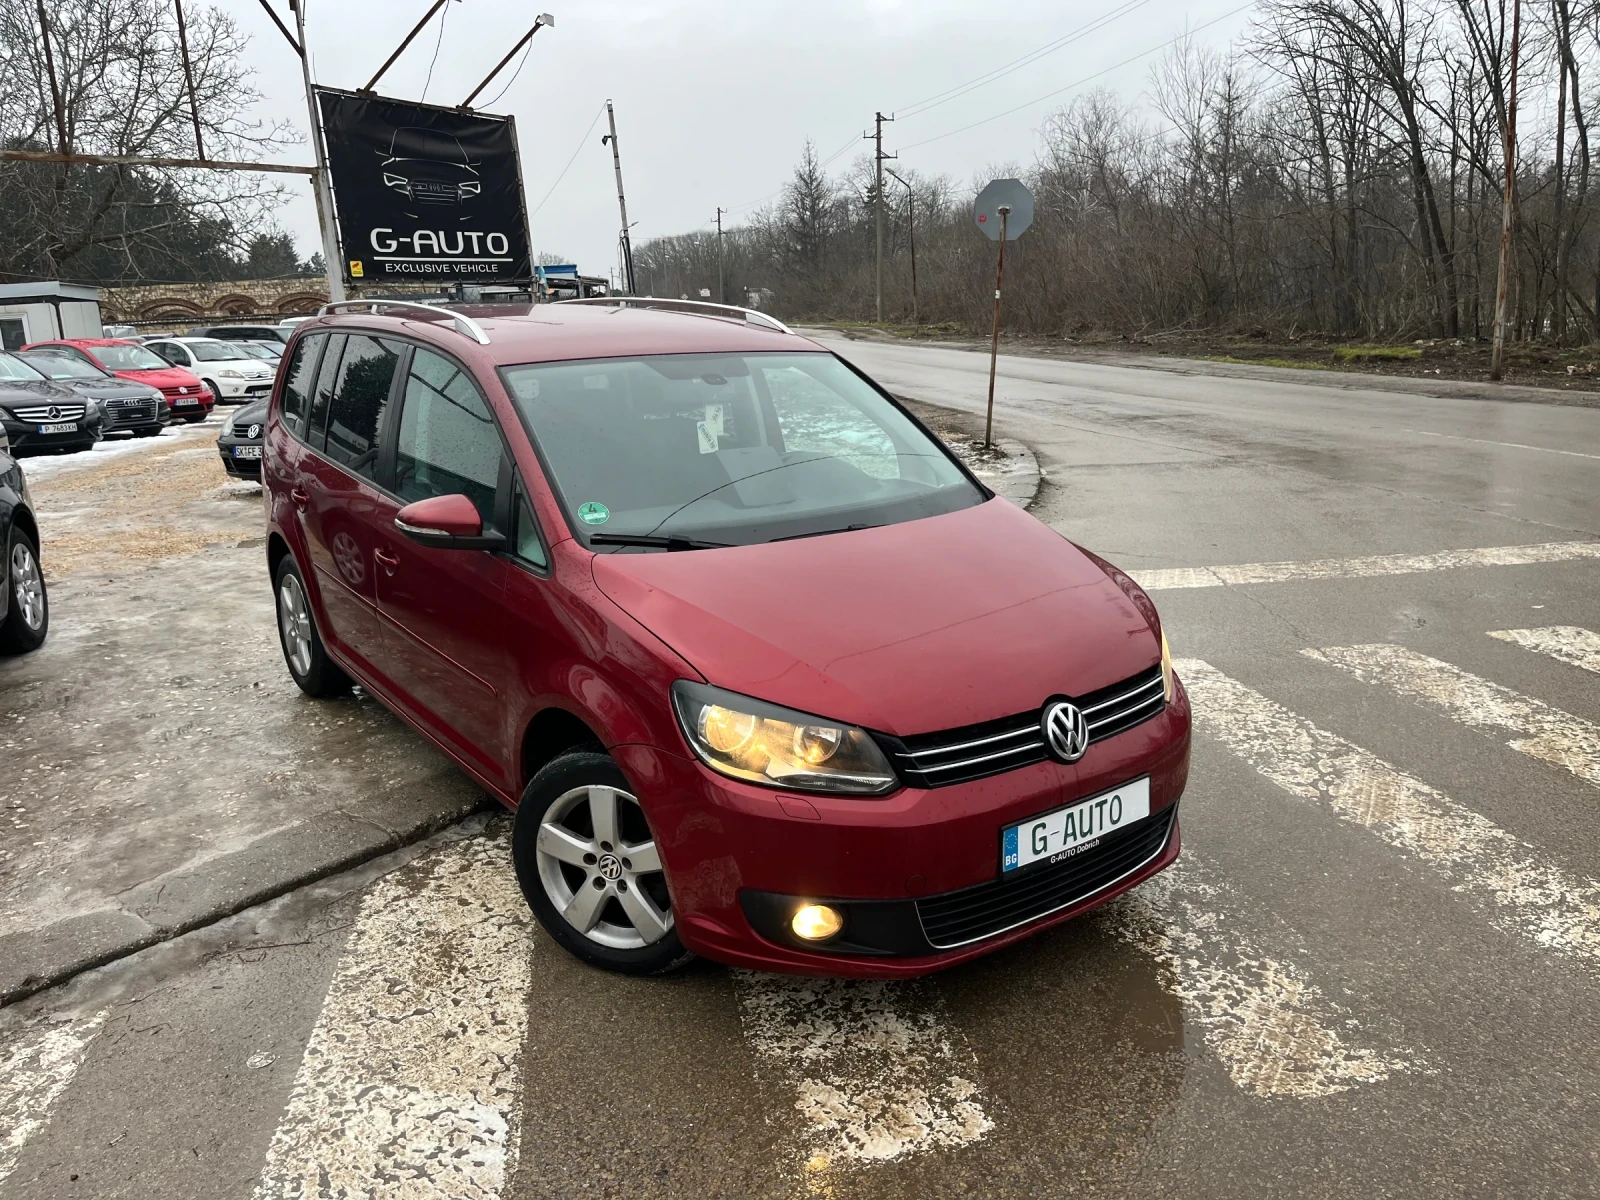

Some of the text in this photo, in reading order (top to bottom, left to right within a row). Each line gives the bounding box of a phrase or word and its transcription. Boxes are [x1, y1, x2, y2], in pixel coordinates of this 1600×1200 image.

[370, 227, 509, 255] G-AUTO
[385, 263, 498, 273] EXCLUSIVE VEHICLE
[1005, 853, 1018, 866] BG
[1050, 838, 1100, 864] G-AUTO Dobrich
